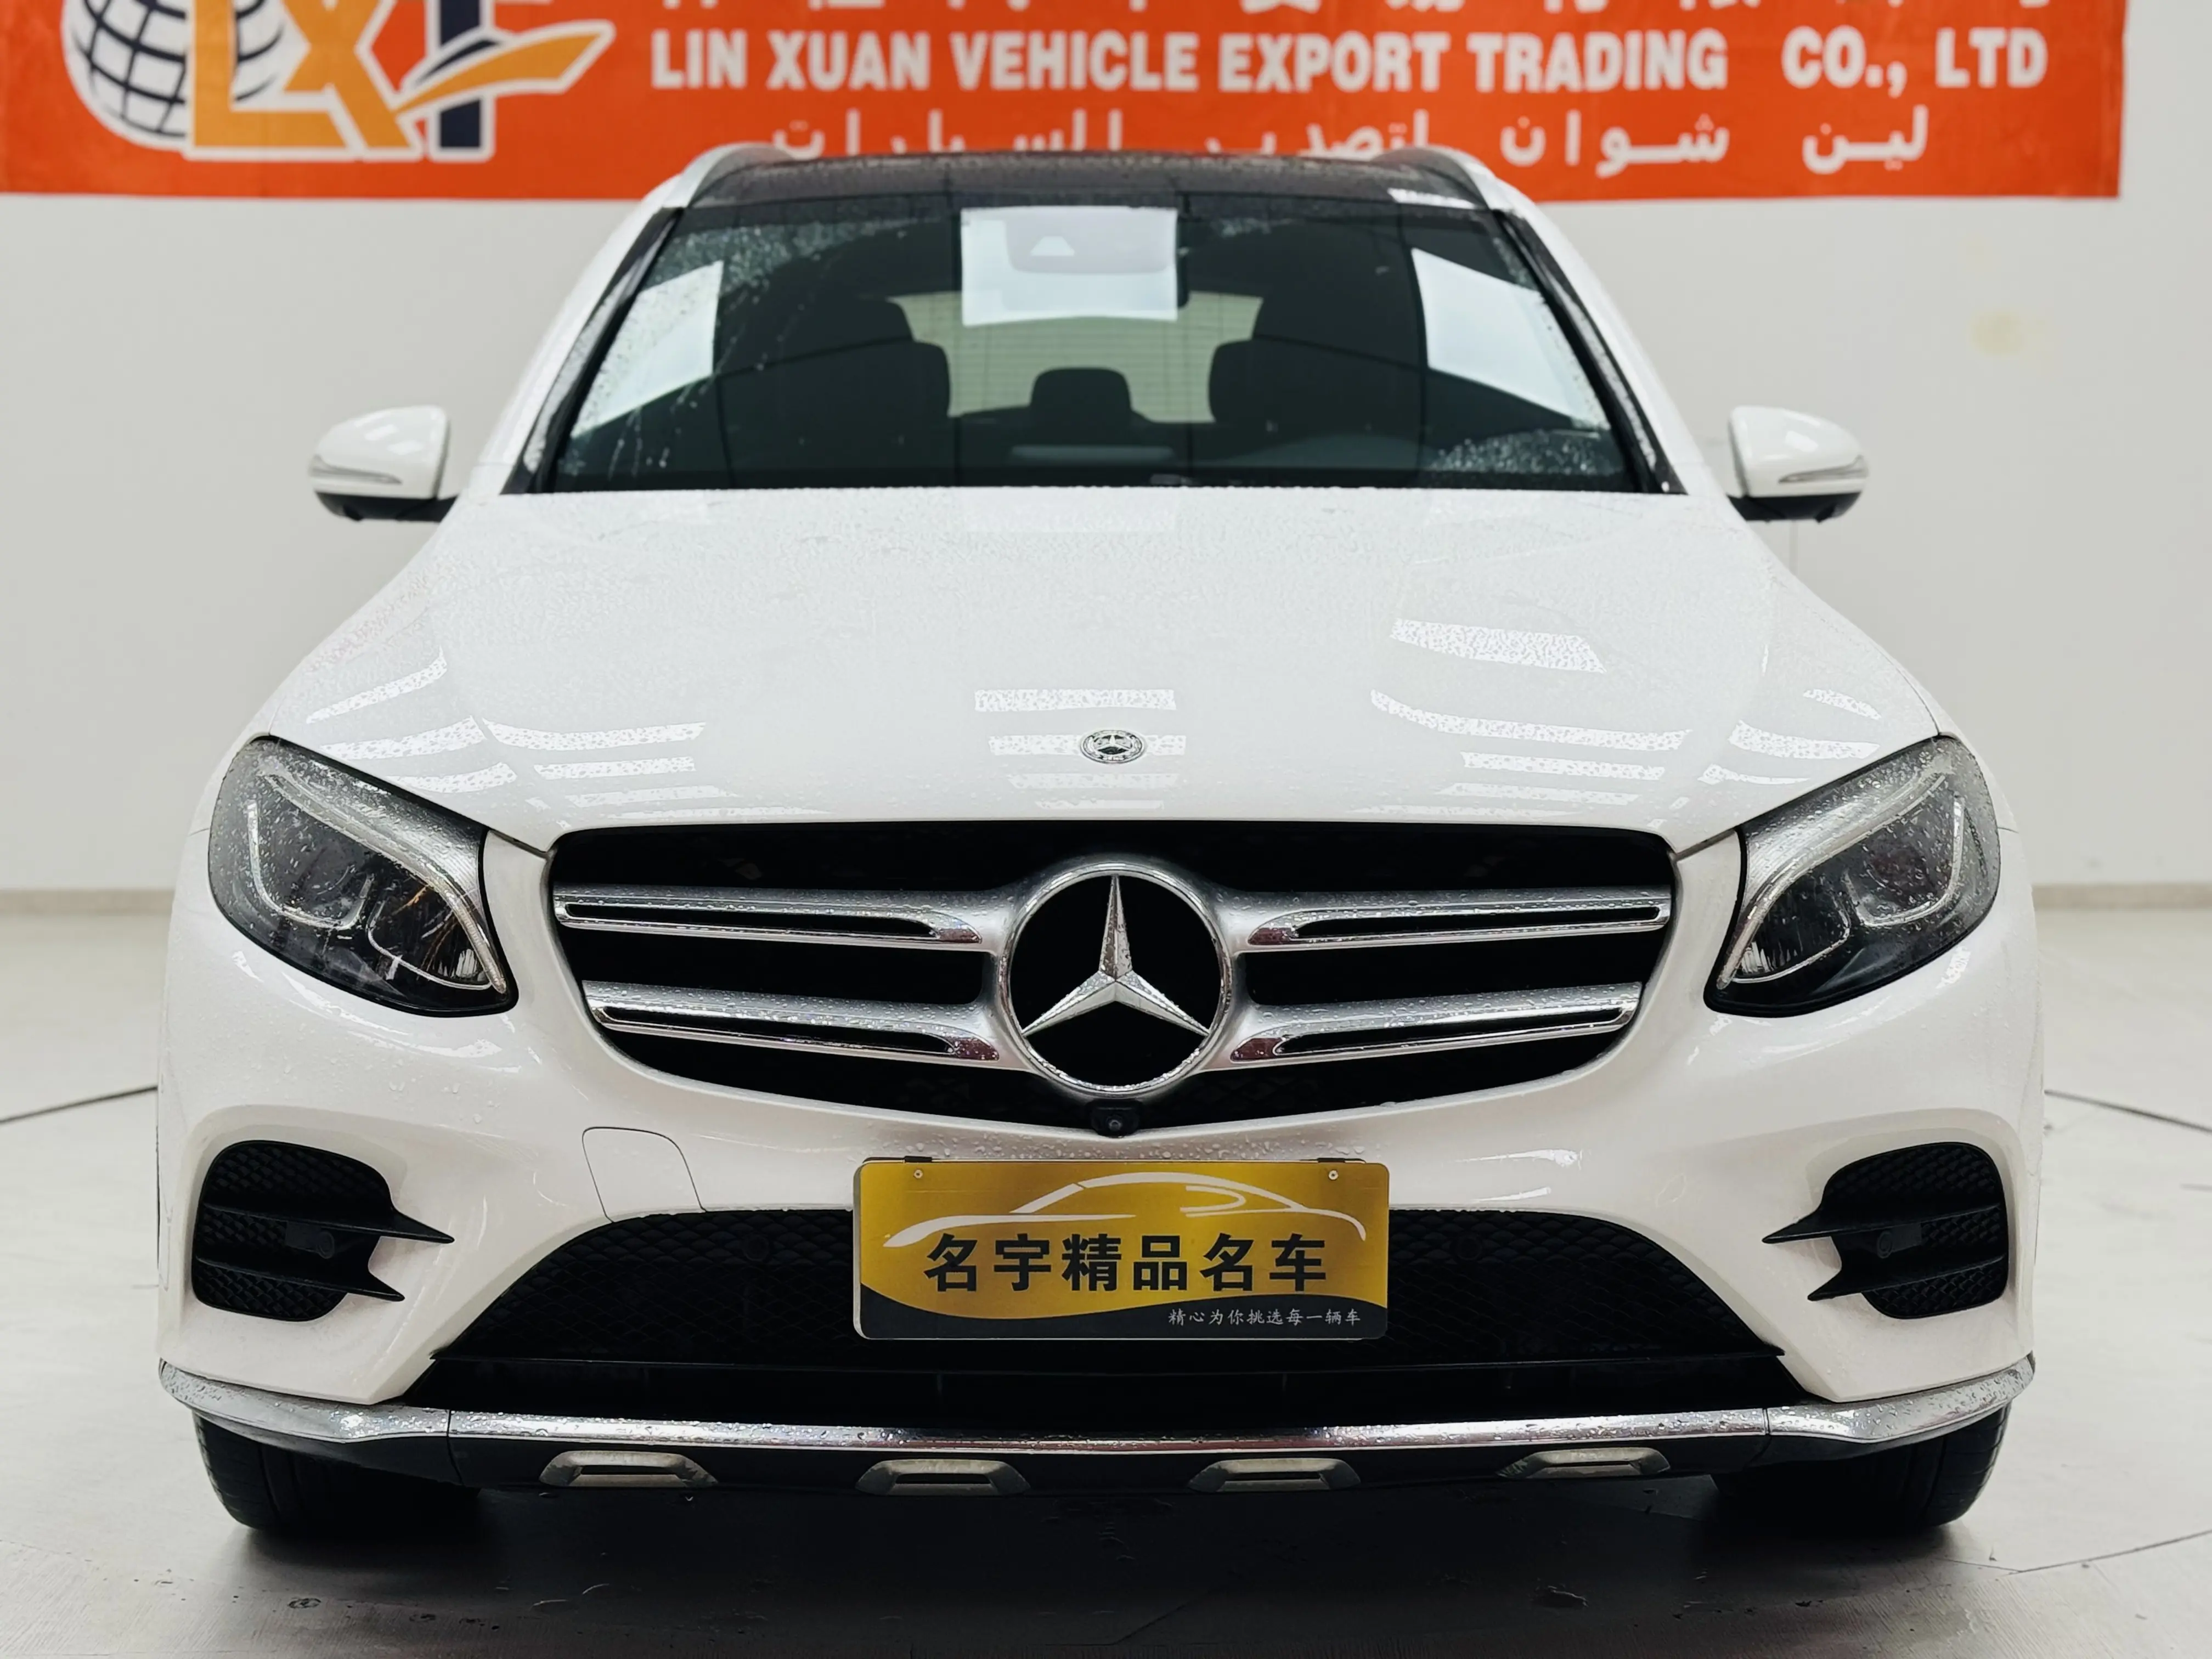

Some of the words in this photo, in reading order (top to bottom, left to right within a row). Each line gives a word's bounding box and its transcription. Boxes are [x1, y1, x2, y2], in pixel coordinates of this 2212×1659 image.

[651, 29, 747, 89] LIN
[766, 30, 930, 92] XUAN
[949, 30, 1199, 92] VEHICLE
[1218, 30, 1451, 93] EXPORT
[1465, 27, 1729, 93] TRADING
[1781, 25, 1908, 98] CO.,
[1934, 26, 2049, 88] LTD
[1498, 108, 1730, 179] شوان
[1802, 104, 1929, 175] لين
[923, 1232, 1327, 1293] 名宇精品名车
[1167, 1308, 1361, 1327] 精心为你挑选每一辆车
